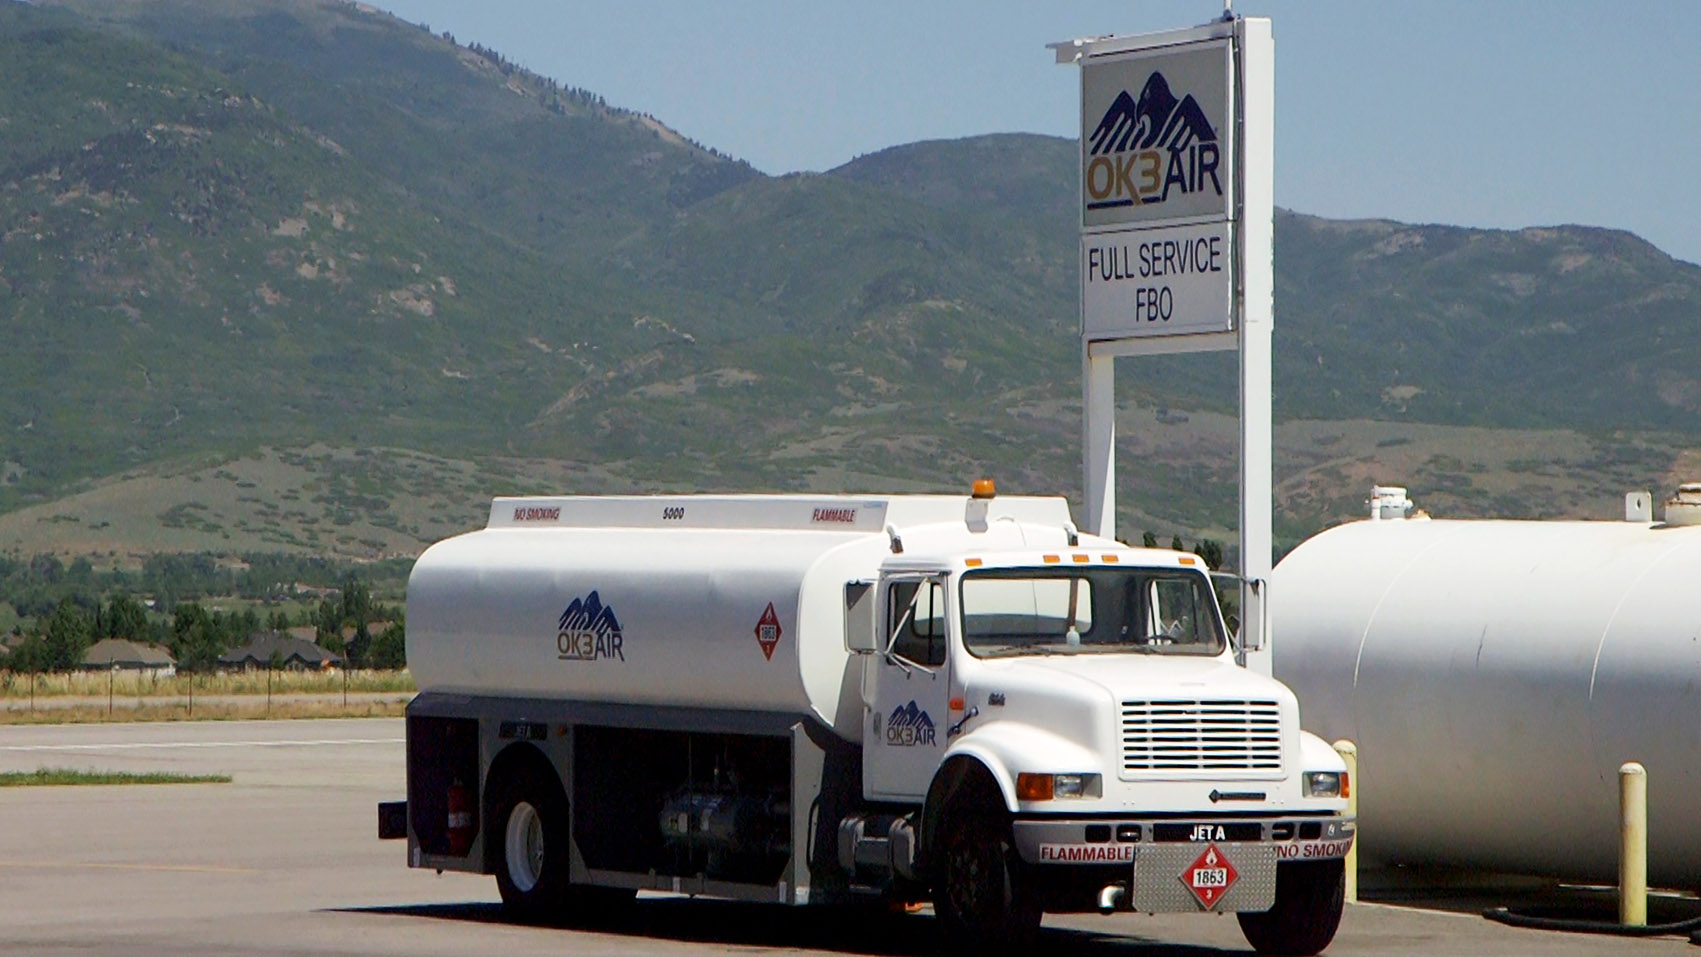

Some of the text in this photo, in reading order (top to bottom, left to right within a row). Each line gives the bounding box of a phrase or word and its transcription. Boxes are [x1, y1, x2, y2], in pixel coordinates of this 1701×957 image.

[1087, 143, 1222, 206] OK3AIR
[1089, 236, 1221, 281] FULL SERVICE
[1136, 285, 1173, 322] FBO
[514, 507, 560, 520] NO SMOKING
[663, 506, 684, 520] 5000
[812, 508, 856, 522] FLAMMABLE
[557, 632, 625, 662] OK3AIR
[887, 726, 936, 747] OK3AIR
[1189, 824, 1226, 841] JET A
[1041, 846, 1132, 861] FLAMMABLE
[1276, 844, 1299, 858] NO
[1196, 870, 1224, 884] 1863
[1205, 888, 1213, 900] 3
